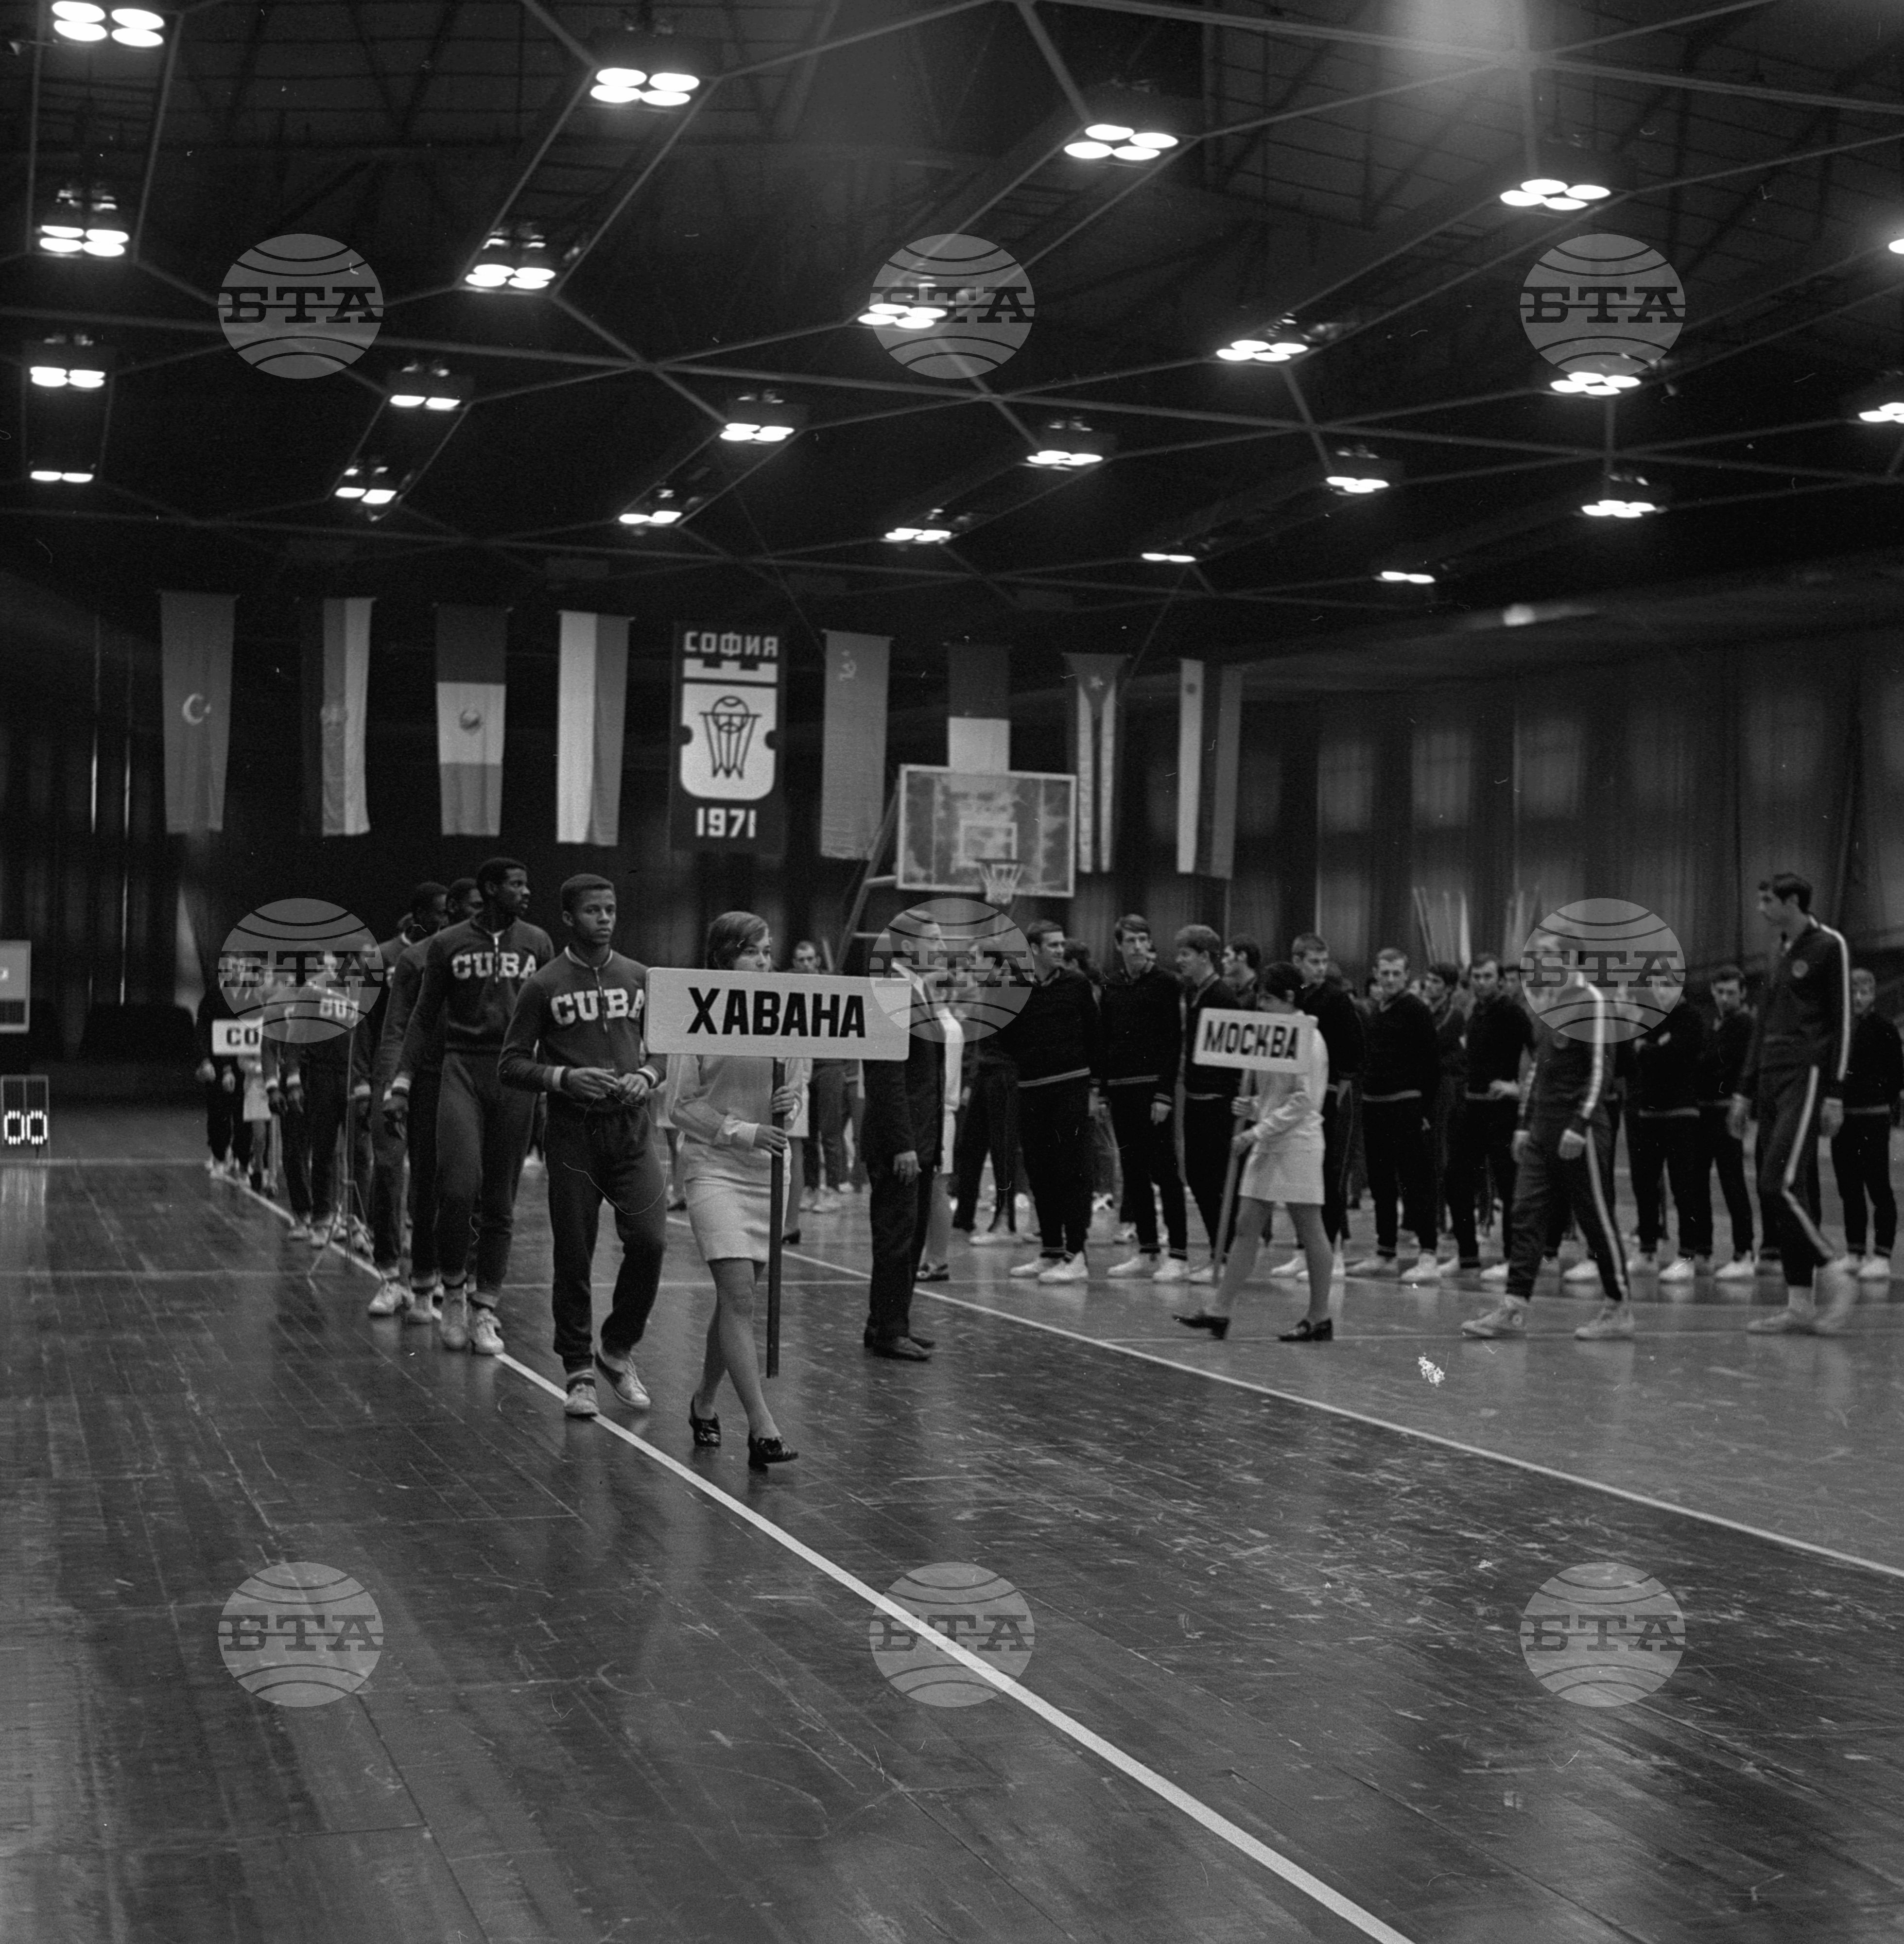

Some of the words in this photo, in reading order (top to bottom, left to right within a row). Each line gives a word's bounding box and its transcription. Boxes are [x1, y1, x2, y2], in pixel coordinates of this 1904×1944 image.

[684, 631, 778, 657] СОФИЯ
[696, 807, 757, 839] 1971
[452, 952, 537, 979] CUBA
[551, 988, 645, 1025] CUBA
[686, 987, 866, 1038] ХАВАНА
[1202, 1020, 1299, 1060] МОСКВА
